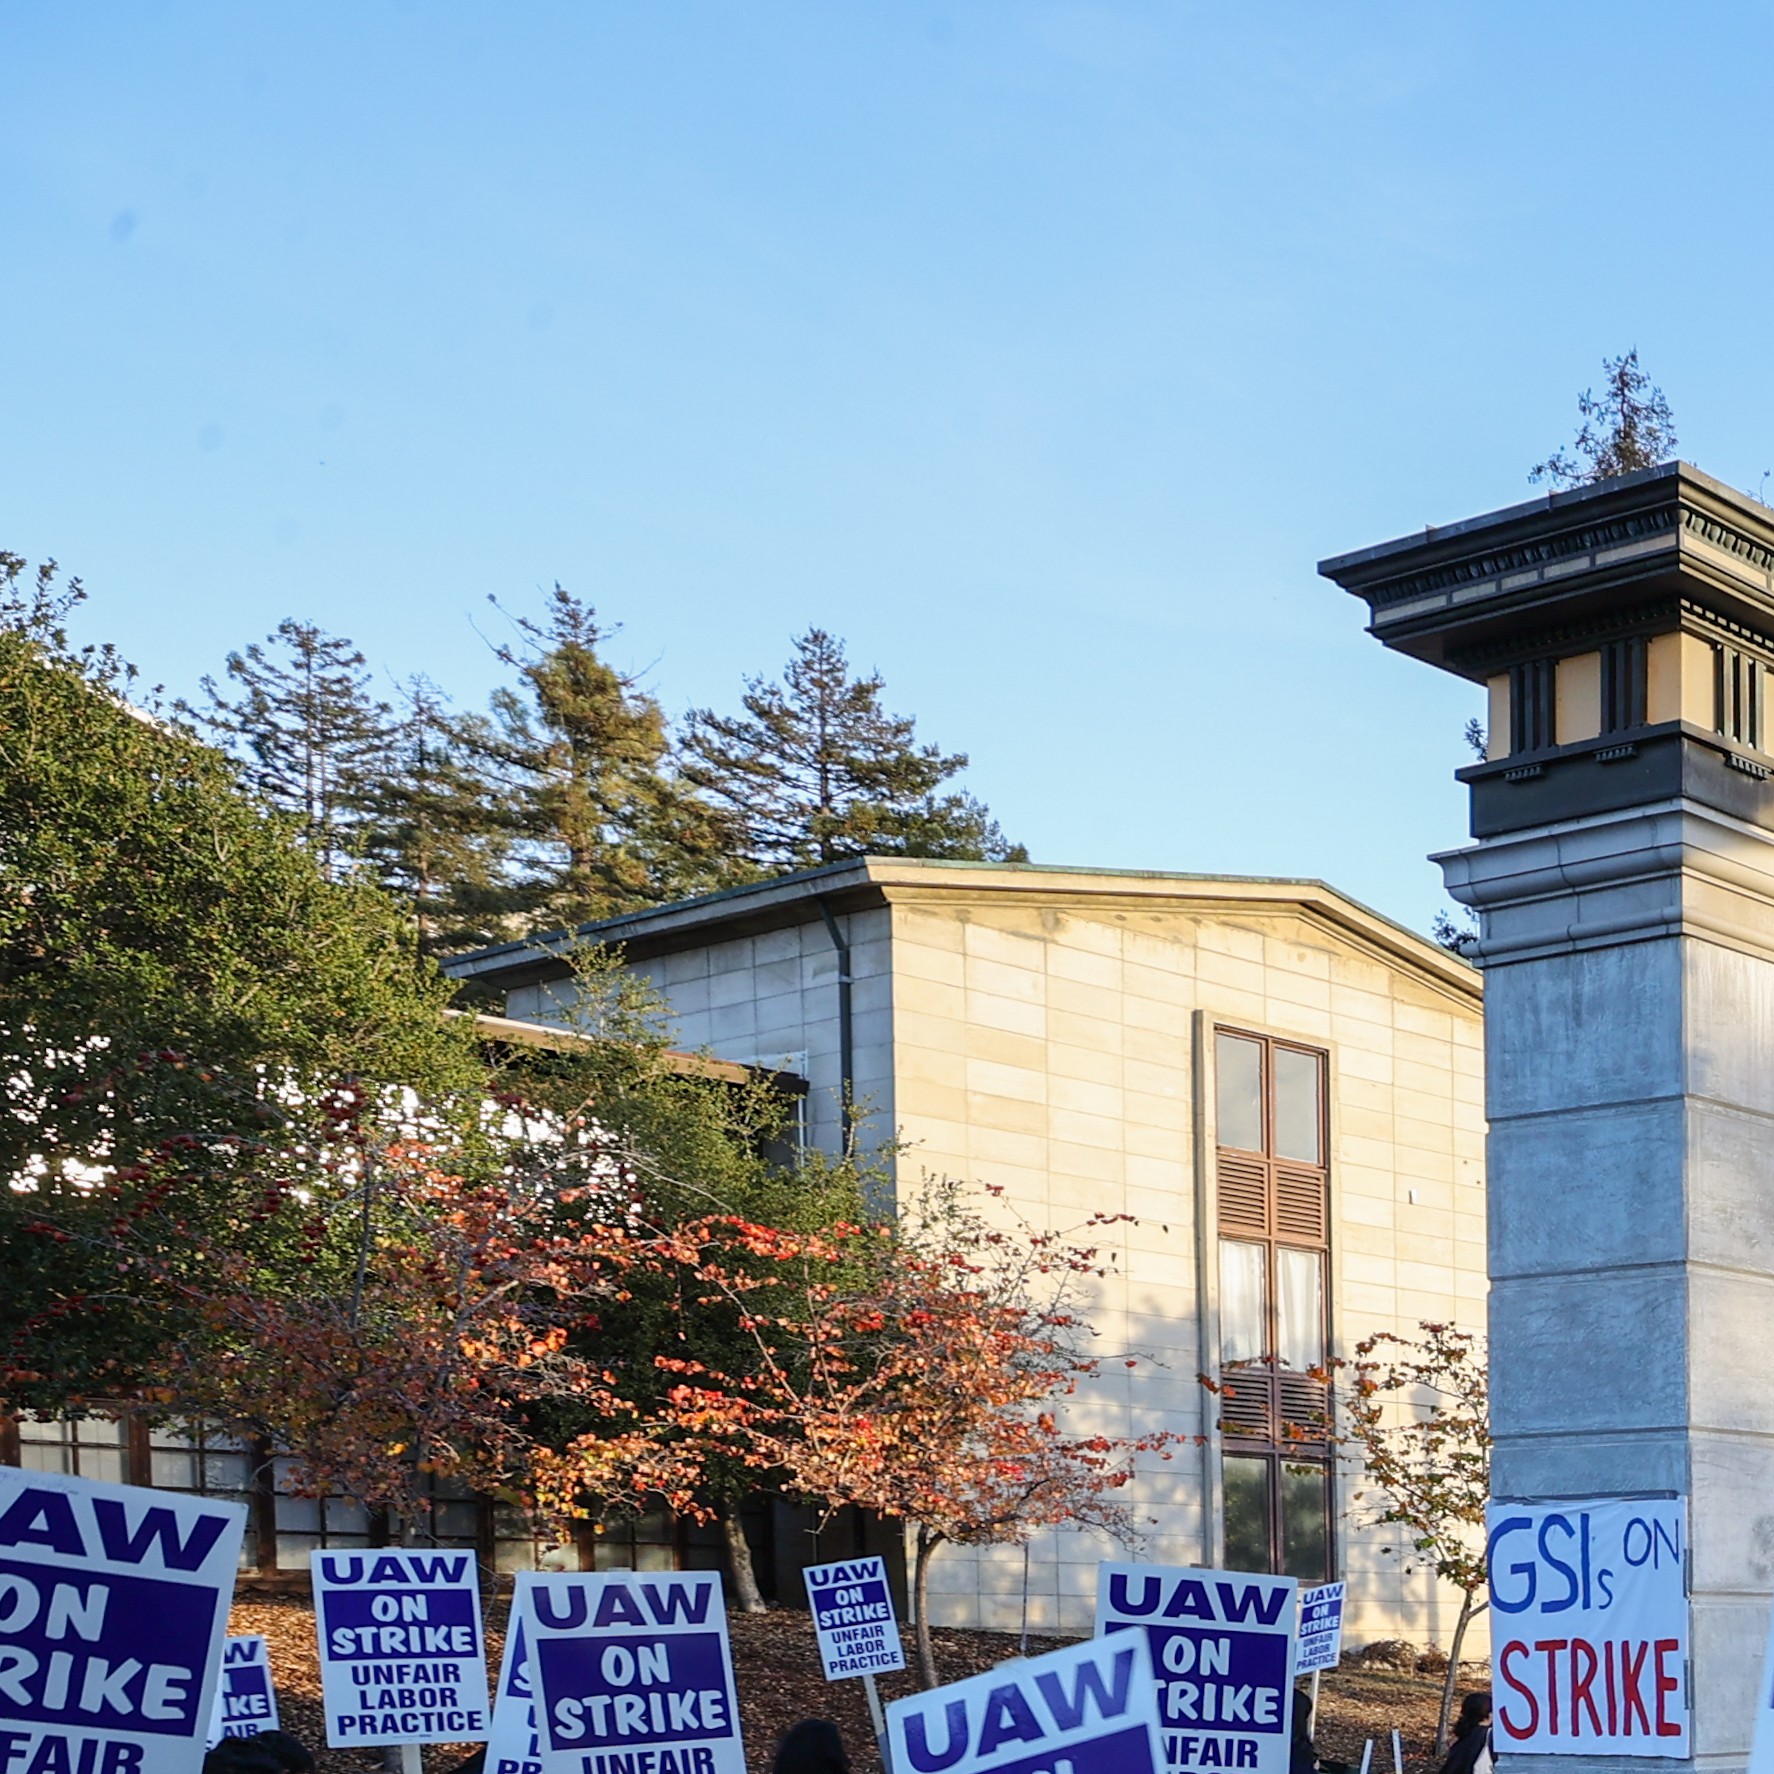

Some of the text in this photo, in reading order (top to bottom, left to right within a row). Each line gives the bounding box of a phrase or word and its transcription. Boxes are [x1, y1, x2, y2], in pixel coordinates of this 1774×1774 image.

[0, 1488, 229, 1571] AW
[321, 1557, 468, 1584] UAW
[809, 1561, 878, 1586] UAW
[1487, 1513, 1679, 1613] GSIs ON
[0, 1573, 109, 1641] ON
[371, 1594, 427, 1622] ON
[531, 1583, 712, 1629] UAW
[835, 1587, 864, 1605] ON
[1110, 1574, 1289, 1625] UAW
[1303, 1585, 1343, 1604] UAW
[820, 1602, 888, 1627] STRIKE
[1312, 1604, 1329, 1618] ON
[832, 1625, 884, 1643] UNFAIR
[1301, 1615, 1339, 1635] STRIKE
[332, 1624, 474, 1655] STRIKE
[837, 1640, 885, 1657] LABOR
[601, 1643, 670, 1686] ON
[829, 1652, 899, 1673] PRACTICE
[1163, 1635, 1230, 1676] ON
[0, 1645, 192, 1719] RIKE
[352, 1664, 460, 1685] UNFAIR
[360, 1688, 457, 1710] LABOR
[1499, 1638, 1681, 1741] STRIKE
[337, 1711, 483, 1737] PRACTICE
[554, 1689, 726, 1739] STRIKE
[903, 1648, 1136, 1773] UAW
